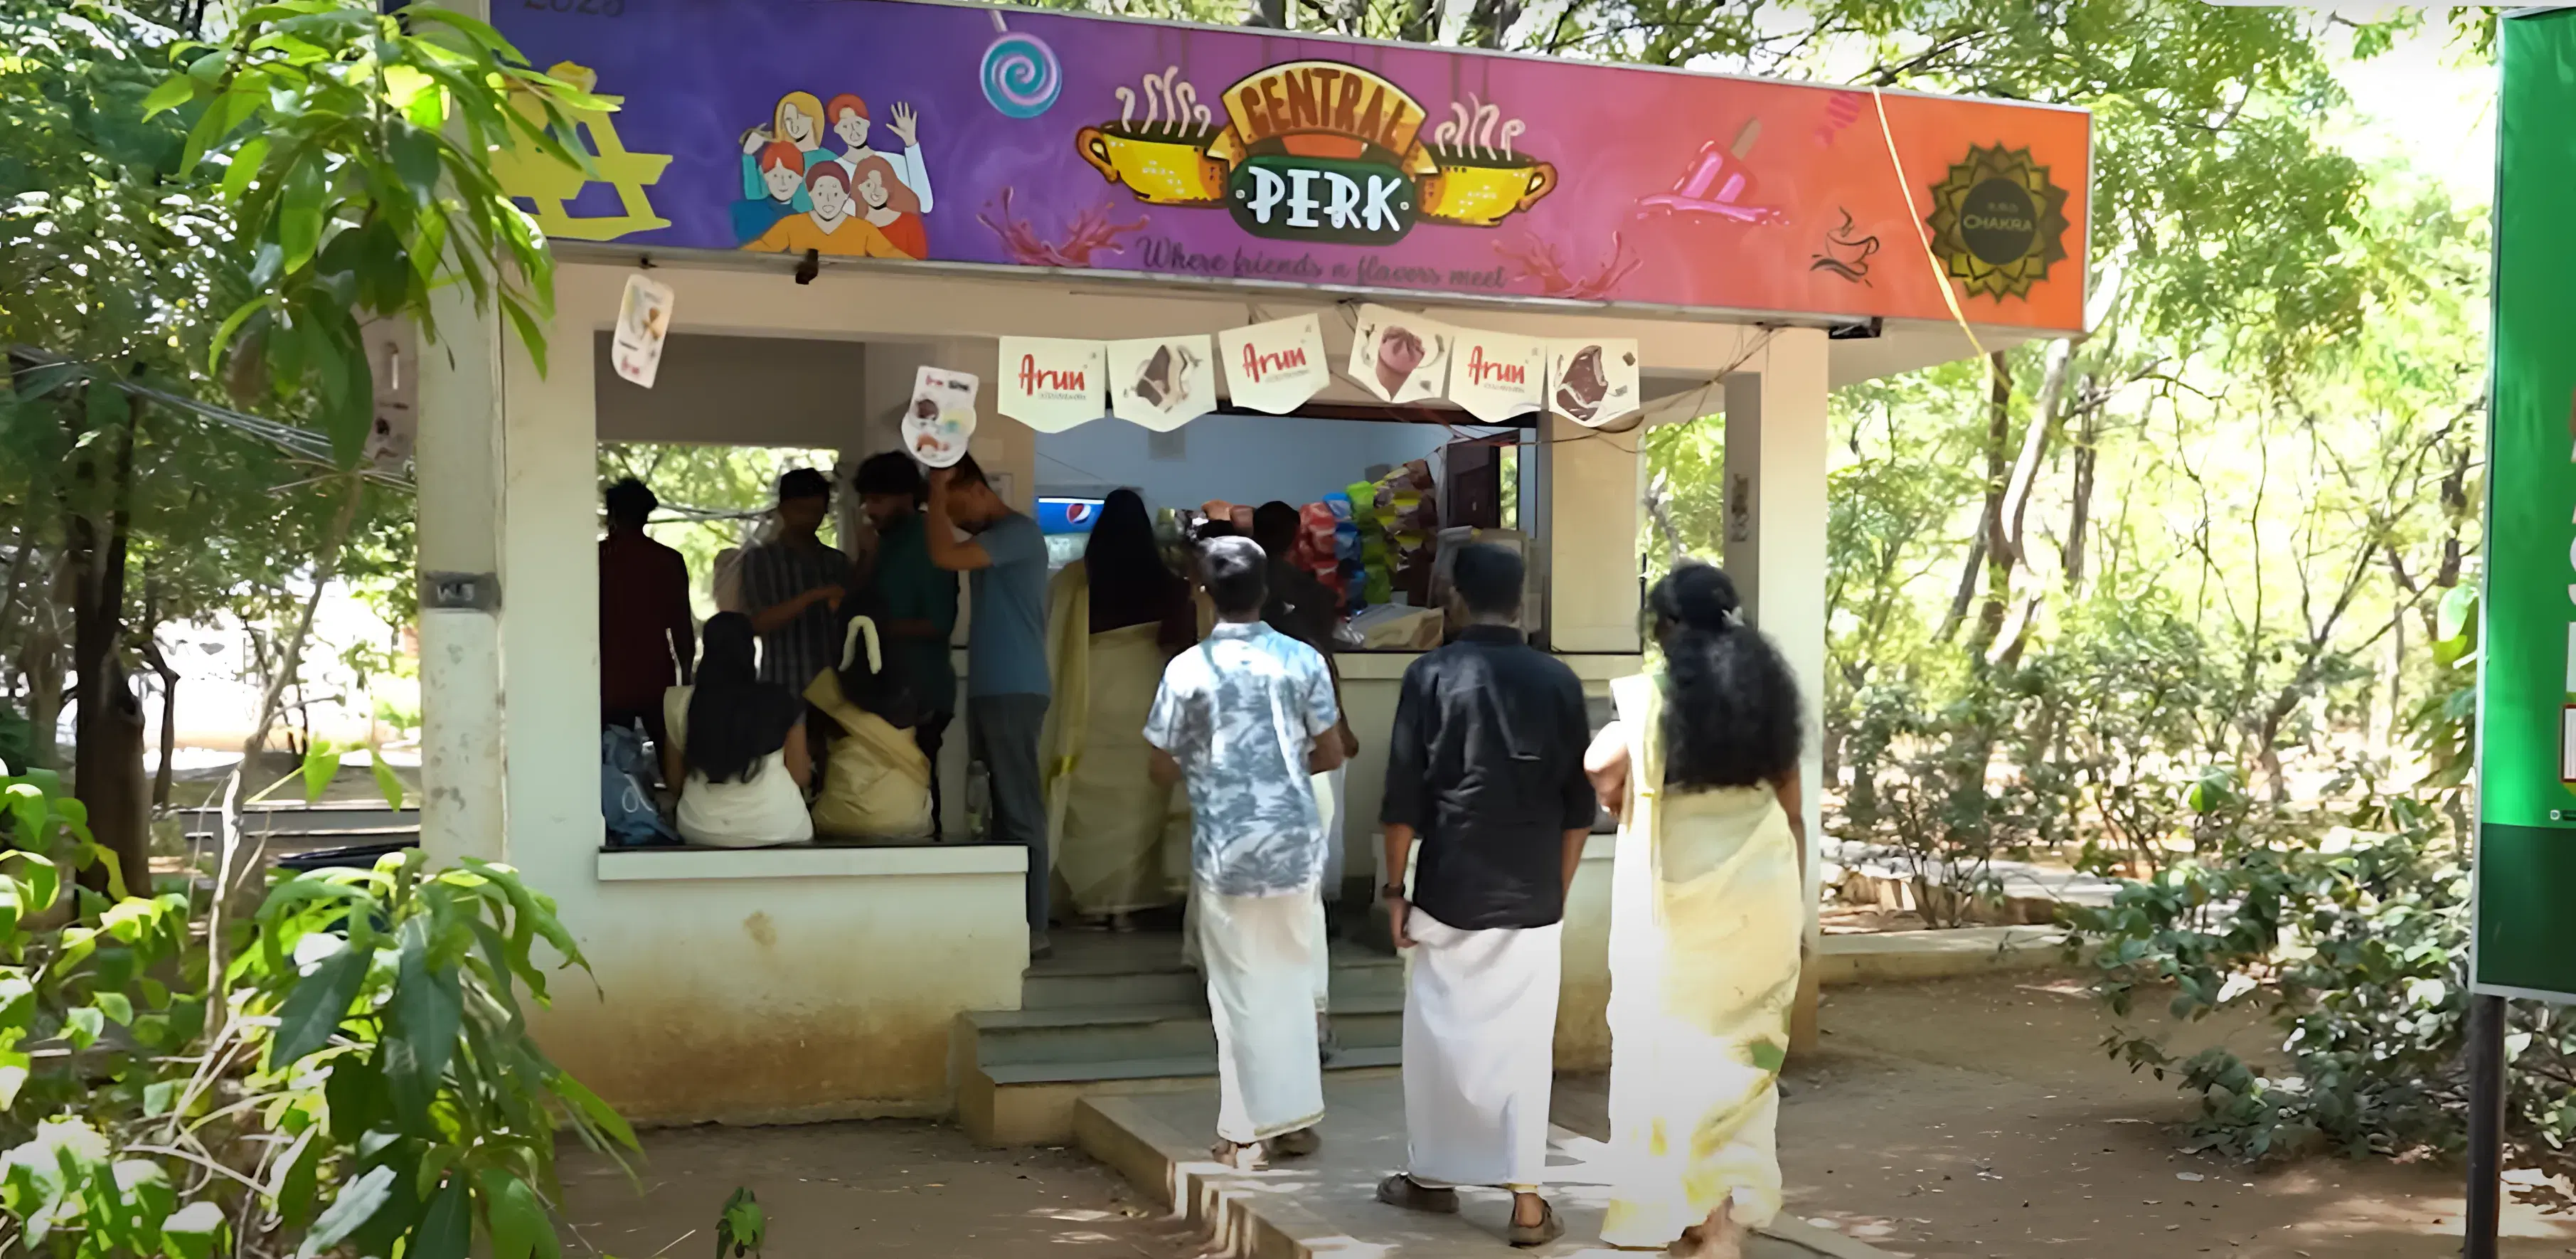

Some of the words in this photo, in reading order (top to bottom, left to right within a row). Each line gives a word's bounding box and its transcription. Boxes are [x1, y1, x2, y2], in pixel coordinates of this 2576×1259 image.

[1240, 68, 1407, 147] CENTRAL
[1247, 166, 1402, 232] PERK
[1963, 214, 2033, 233] CHAKRA
[1135, 234, 1230, 273] Where
[1234, 245, 1323, 278] friends
[1357, 255, 1441, 285] flavors
[1449, 265, 1507, 288] meet
[1018, 354, 1085, 397] Arun
[1242, 342, 1306, 383] Arun
[1467, 345, 1525, 386] Arun
